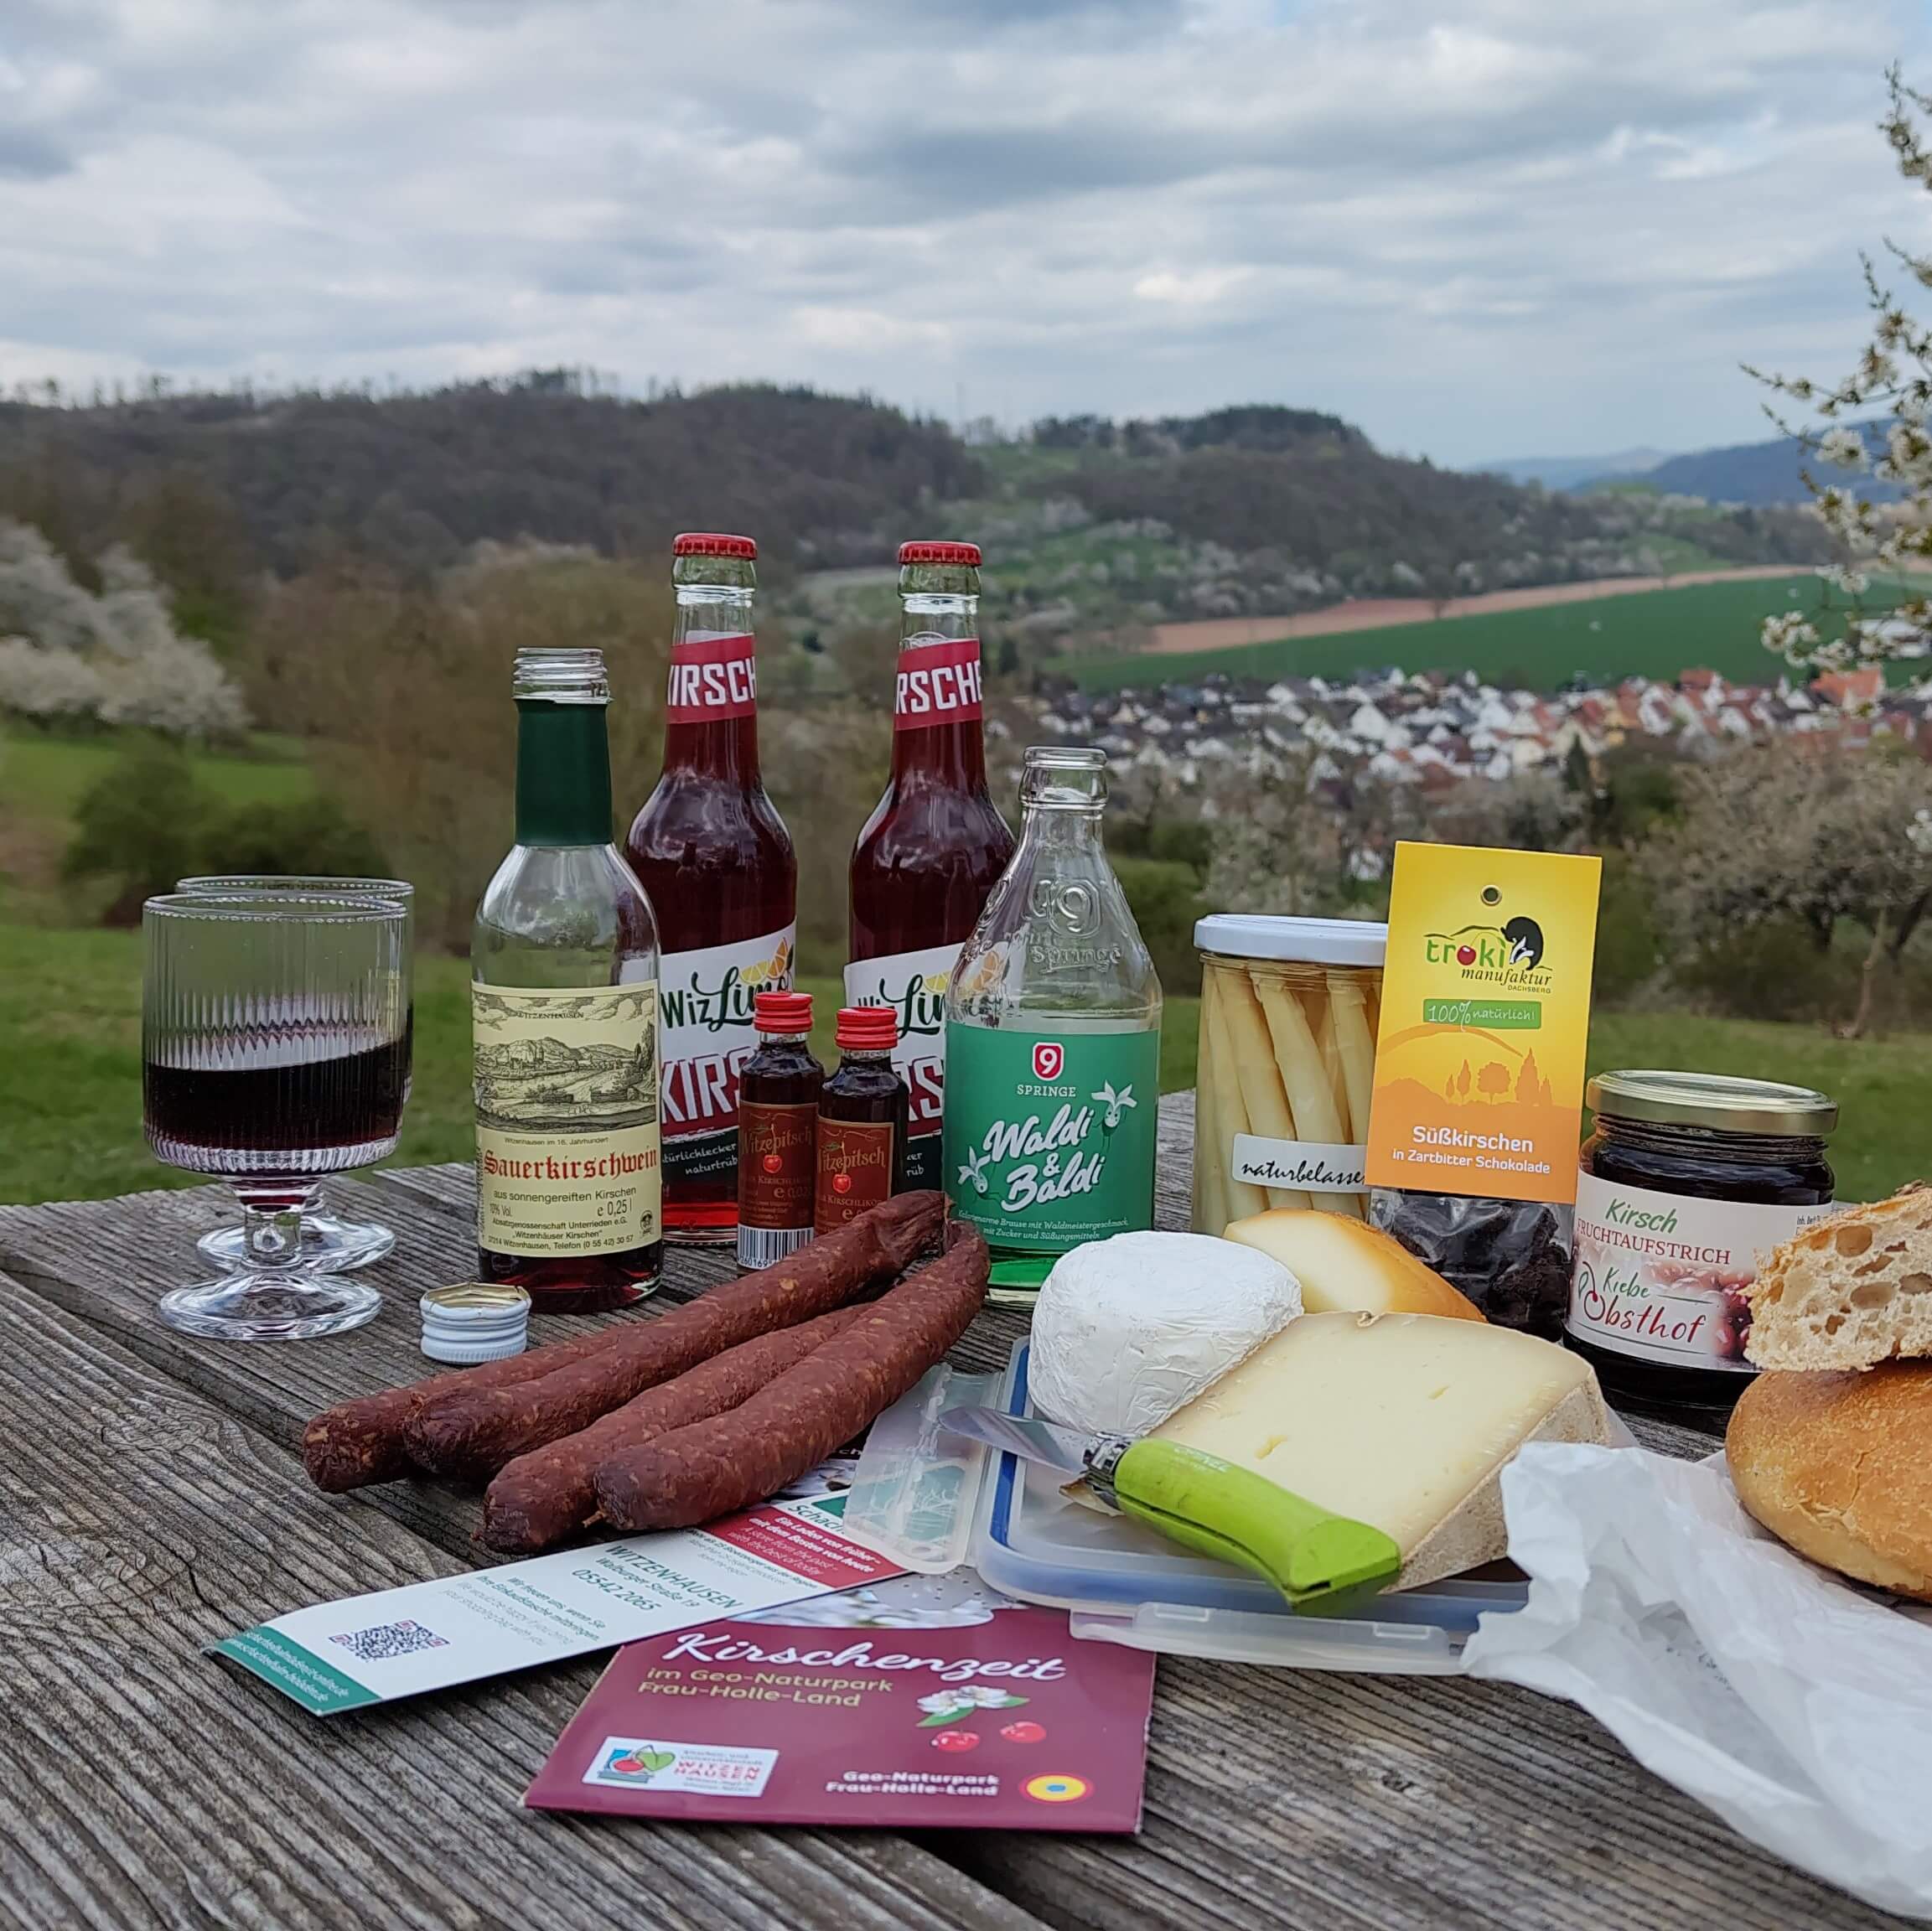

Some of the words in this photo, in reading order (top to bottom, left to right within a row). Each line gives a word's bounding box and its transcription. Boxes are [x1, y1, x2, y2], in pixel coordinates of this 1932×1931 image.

[1461, 966, 1552, 986] manufaktur
[1507, 984, 1551, 995] DACHSBERG
[1428, 1001, 1472, 1032] 100%
[1473, 1010, 1536, 1021] natürlich!
[1039, 1048, 1058, 1074] 9
[1017, 1085, 1076, 1097] SPRINGE
[982, 1103, 1094, 1162] Waldi
[1412, 1126, 1533, 1153] Süßkirschen
[484, 1146, 657, 1180] Sauerkirschwein
[1043, 1152, 1060, 1177] &
[1407, 1150, 1473, 1167] Zartbitter
[1475, 1156, 1551, 1174] Schokolade
[1001, 1151, 1106, 1212] Baldi
[493, 1190, 507, 1199] aus
[510, 1192, 592, 1204] sonnengereiften
[595, 1187, 636, 1199] Kirschen
[607, 1198, 627, 1217] 0,25
[568, 1219, 613, 1230] Unterrieden
[1001, 1218, 1027, 1229] Brause
[1028, 1219, 1042, 1229] mit
[1605, 1198, 1678, 1235] Kirsch
[554, 1241, 581, 1250] Telefon
[996, 1228, 1021, 1239] Zucker
[1023, 1230, 1039, 1240] und
[1577, 1218, 1731, 1265] FRUCHTAUFSTRICH
[1603, 1266, 1650, 1299] Kiebe
[1583, 1289, 1707, 1343] Obsthof
[572, 1568, 624, 1593] 05542
[614, 1590, 662, 1611] 2065
[605, 1545, 744, 1609] WITZENHAUSEN
[661, 1632, 1067, 1682] Kirschenzeit
[646, 1666, 683, 1681] im
[690, 1669, 894, 1693] Geo-Naturpark
[637, 1681, 862, 1708] Frau-Holle-Land
[825, 1781, 999, 1796] Frau-Holle-Land
[842, 1770, 1000, 1786] Geo-Naturpark
